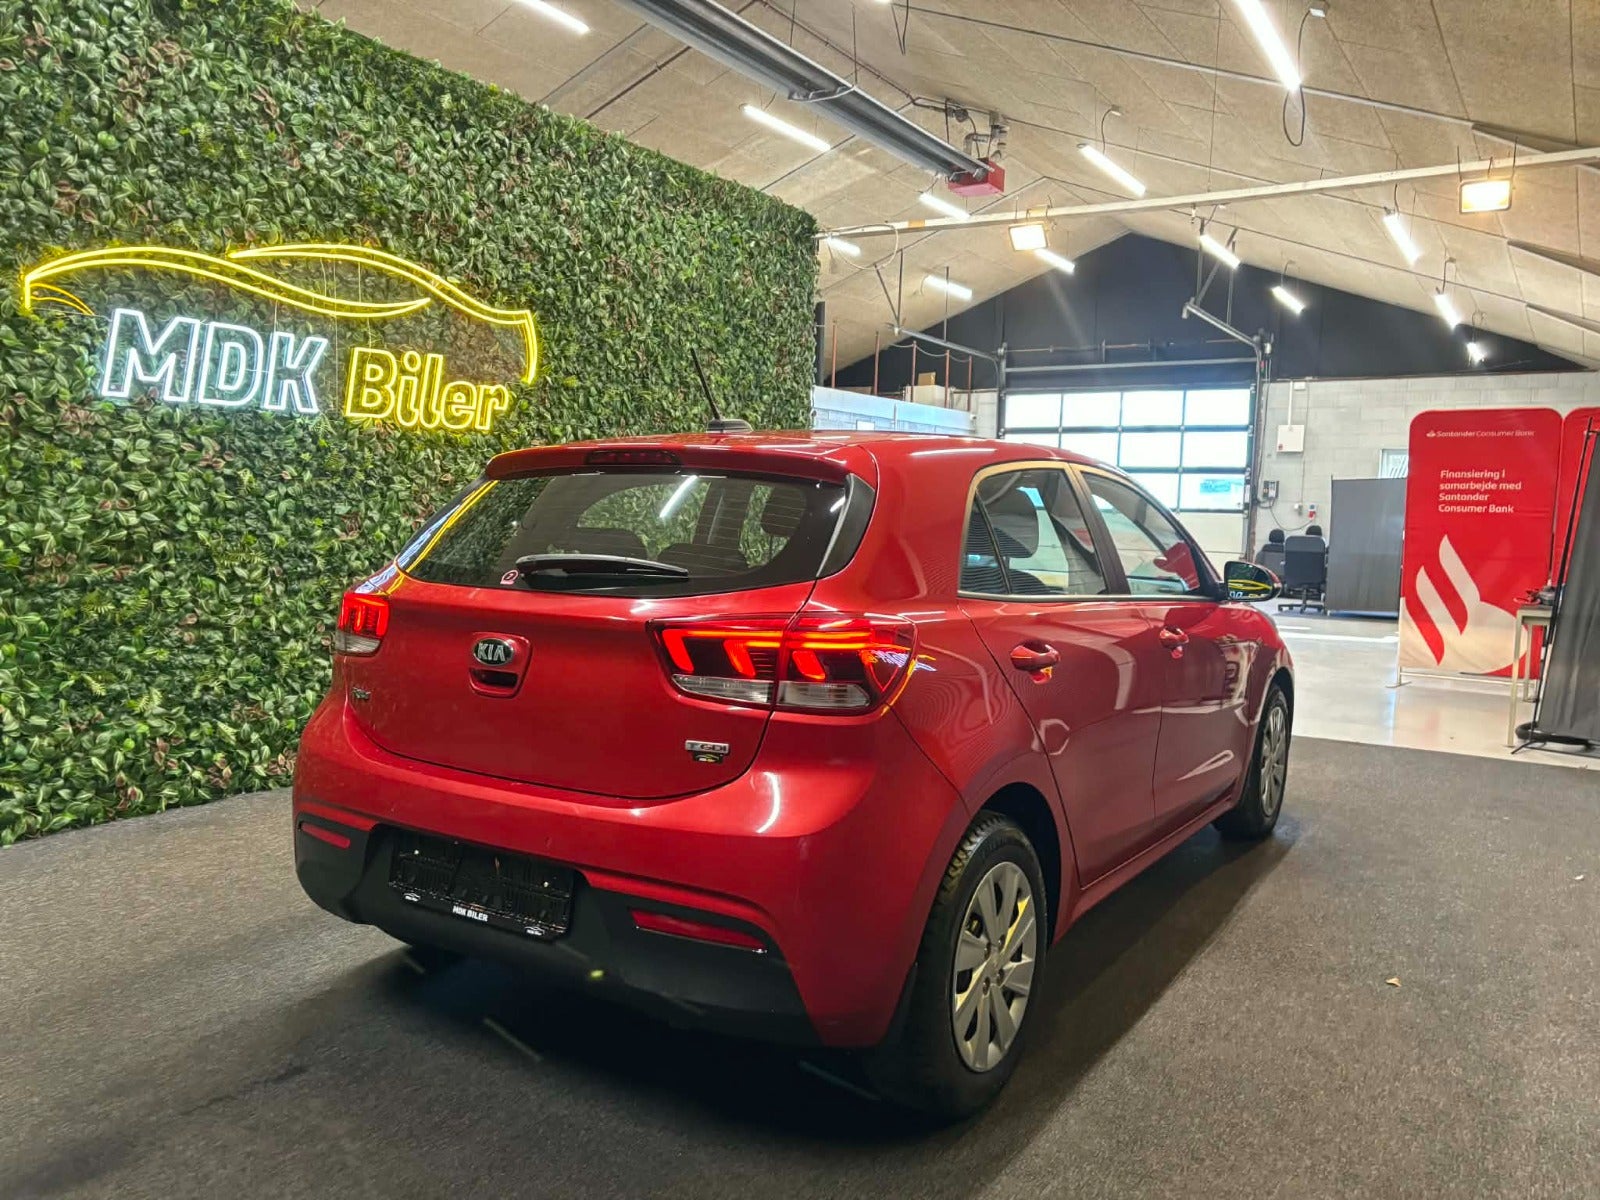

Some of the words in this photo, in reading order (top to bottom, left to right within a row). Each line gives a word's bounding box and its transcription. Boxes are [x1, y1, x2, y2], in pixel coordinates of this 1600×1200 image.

[100, 307, 328, 414] MDK
[345, 346, 510, 431] Biler
[1440, 469, 1499, 480] Finansiering
[1440, 481, 1497, 491] samarbejde
[1499, 481, 1522, 490] med
[1439, 492, 1489, 501] Santander
[1438, 504, 1487, 513] Consumer
[1488, 504, 1514, 513] Bank
[477, 642, 506, 662] KIA
[466, 909, 489, 922] BILER
